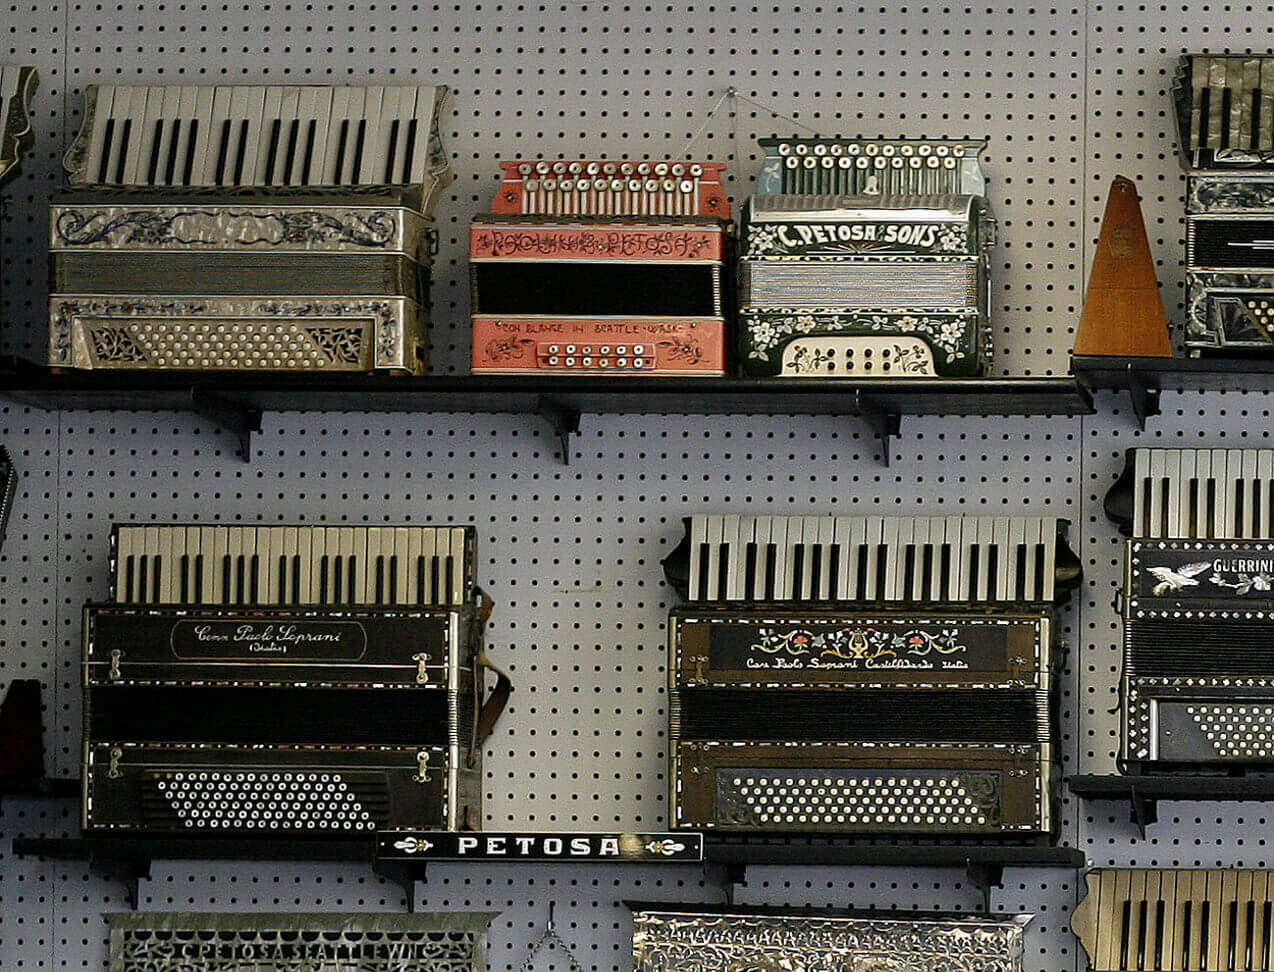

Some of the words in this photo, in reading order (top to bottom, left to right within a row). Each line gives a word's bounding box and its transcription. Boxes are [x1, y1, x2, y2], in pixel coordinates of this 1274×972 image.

[793, 225, 878, 246] PETOSA
[884, 225, 940, 248] SONS
[1213, 559, 1274, 573] GUERRINI
[457, 836, 621, 856] PETOSA
